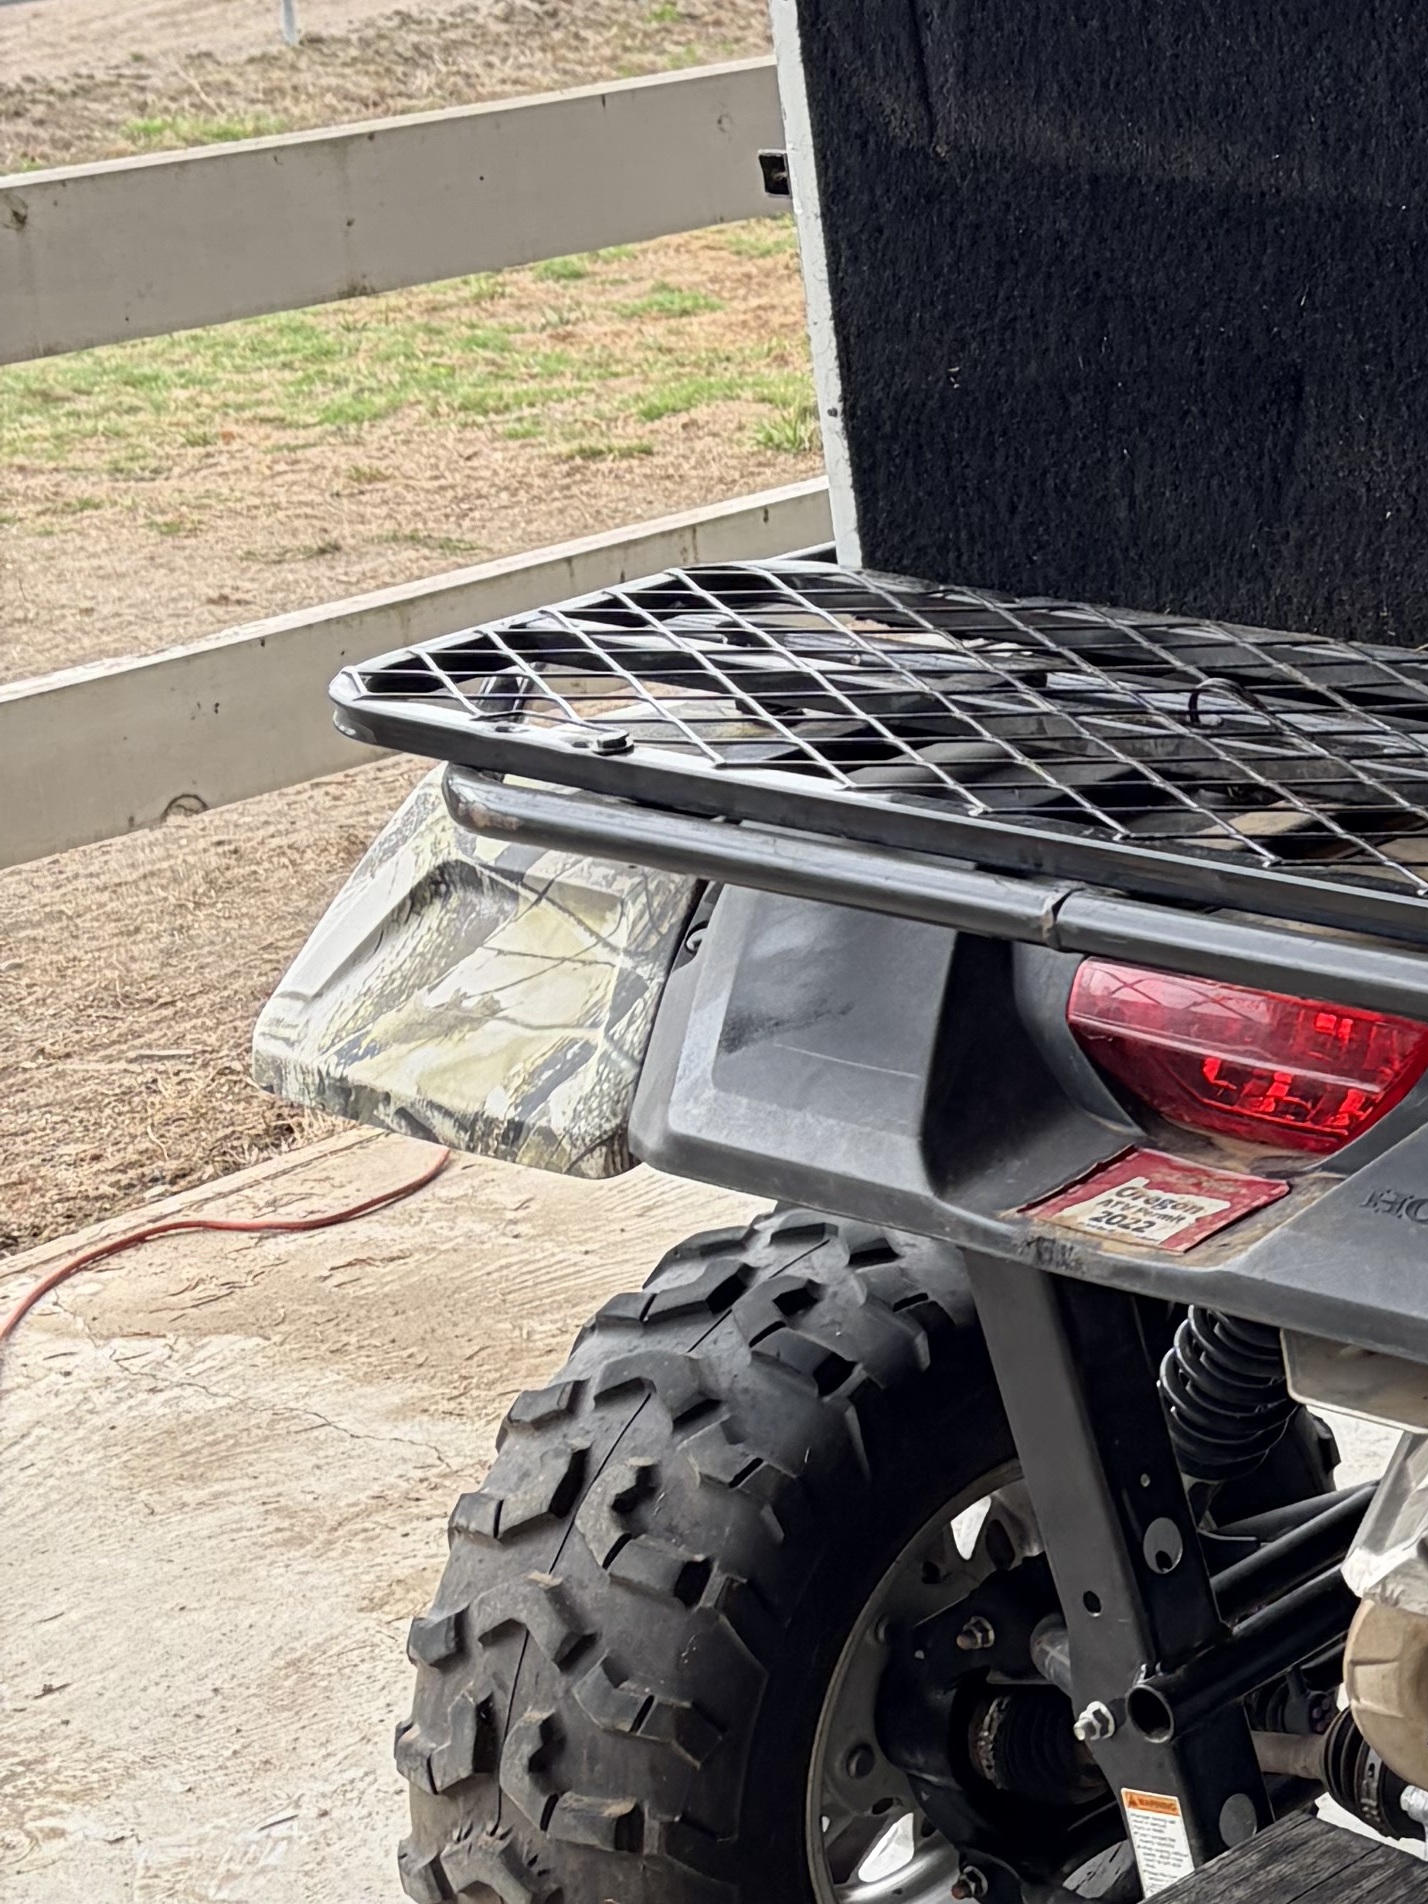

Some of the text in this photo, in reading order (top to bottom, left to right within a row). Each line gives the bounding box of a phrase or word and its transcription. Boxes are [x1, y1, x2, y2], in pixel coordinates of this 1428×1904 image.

[1096, 1198, 1186, 1224] ATV Permit
[1115, 1186, 1205, 1214] Oregon
[1088, 1210, 1156, 1233] 2022
